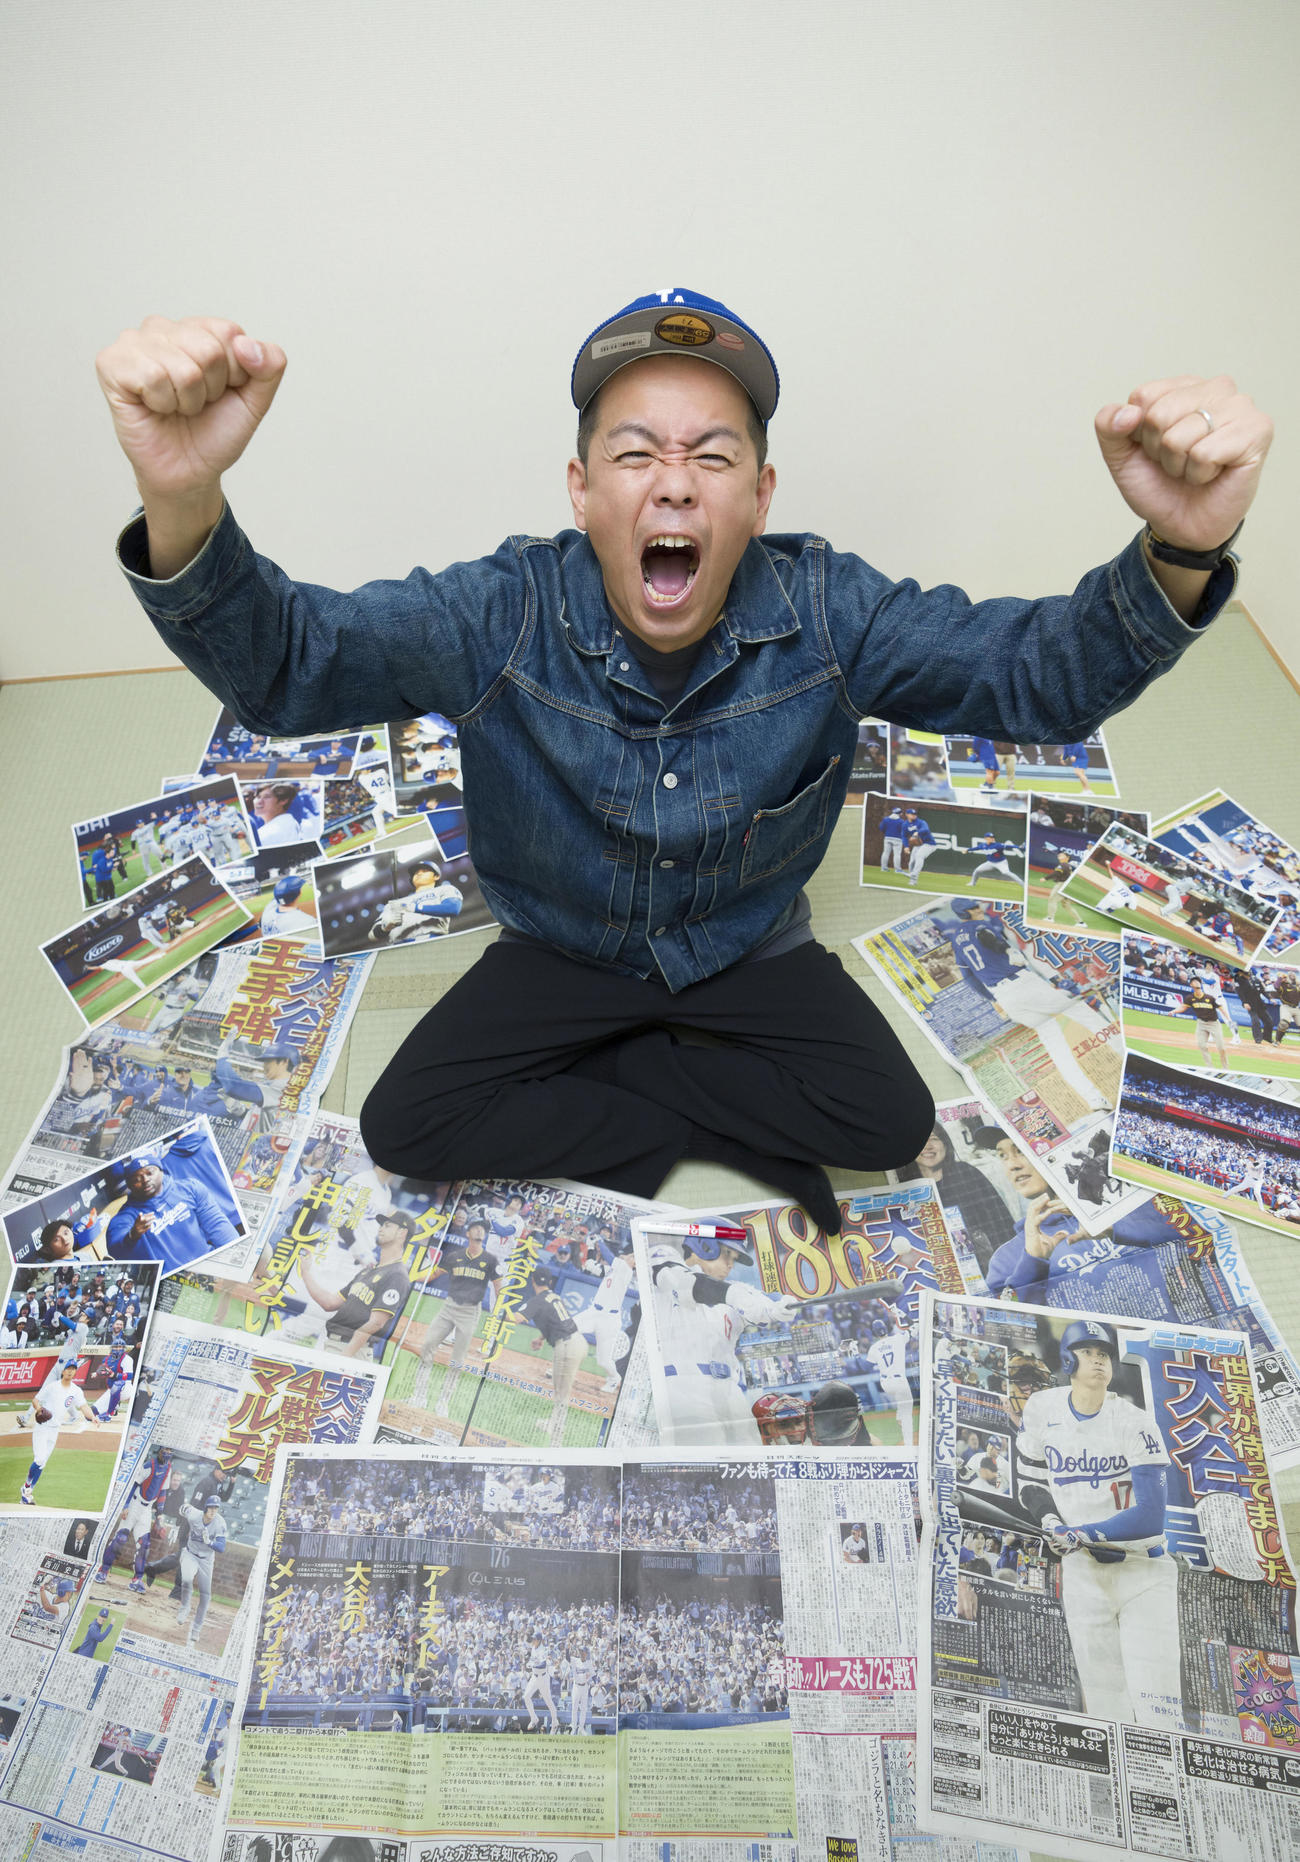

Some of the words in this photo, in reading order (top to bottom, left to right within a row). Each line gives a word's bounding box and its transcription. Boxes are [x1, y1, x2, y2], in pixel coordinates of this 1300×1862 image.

[240, 1177, 343, 1332] 申し訳ない
[216, 1356, 297, 1471] マルチ
[1165, 1352, 1254, 1499] 大谷
[719, 1463, 797, 1480] ファンも待ってた
[1045, 1446, 1129, 1488] Dodgers
[1110, 1481, 1133, 1511] 17
[256, 1558, 295, 1710] メンタリティー
[339, 1561, 373, 1634] 大谷の
[415, 1565, 449, 1669] アーチスト
[1243, 1686, 1288, 1708] GOGO!
[828, 1839, 841, 1851] We
[841, 1840, 857, 1853] love
